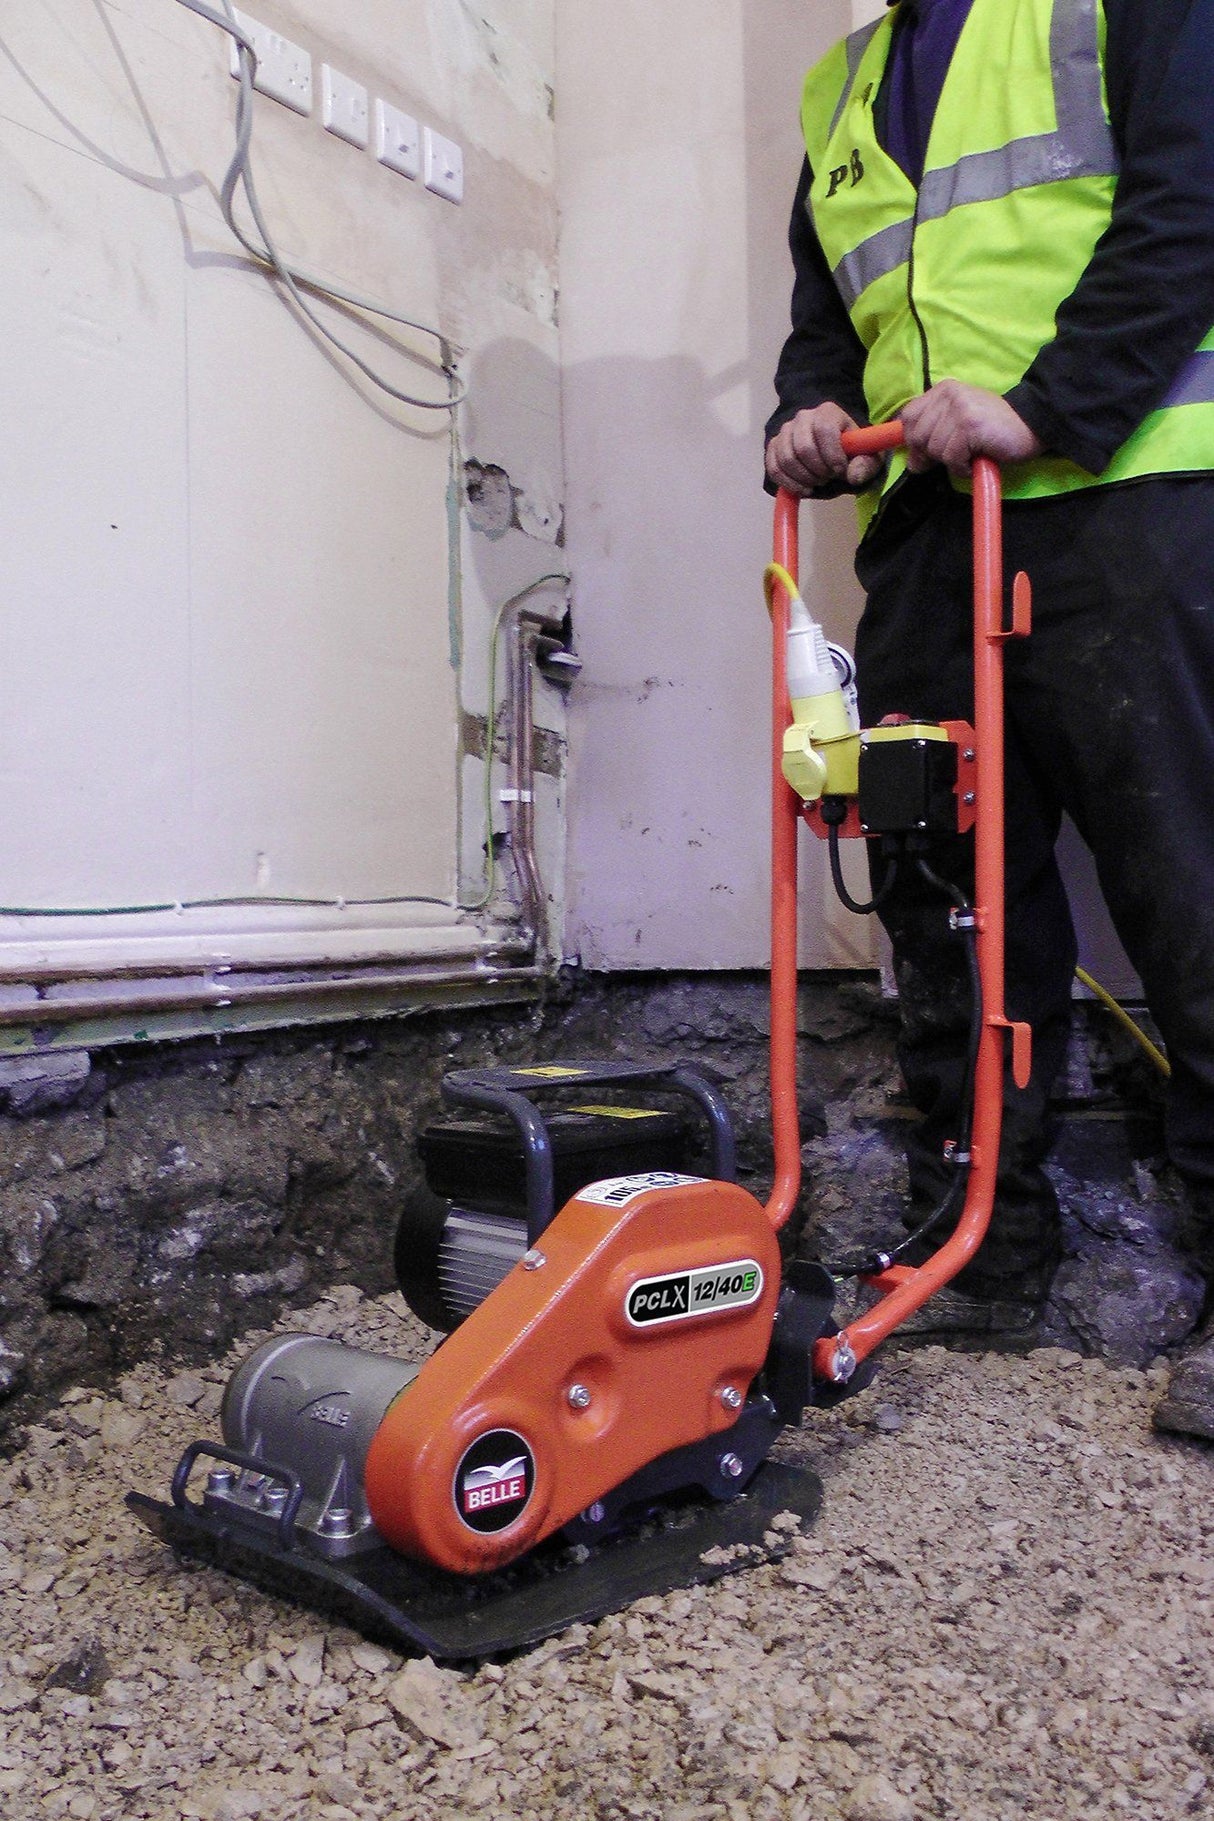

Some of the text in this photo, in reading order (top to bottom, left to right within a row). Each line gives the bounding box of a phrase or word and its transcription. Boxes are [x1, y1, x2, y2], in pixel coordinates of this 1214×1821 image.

[632, 1271, 757, 1315] PCLX 12/40E
[468, 1480, 521, 1509] BELLE
